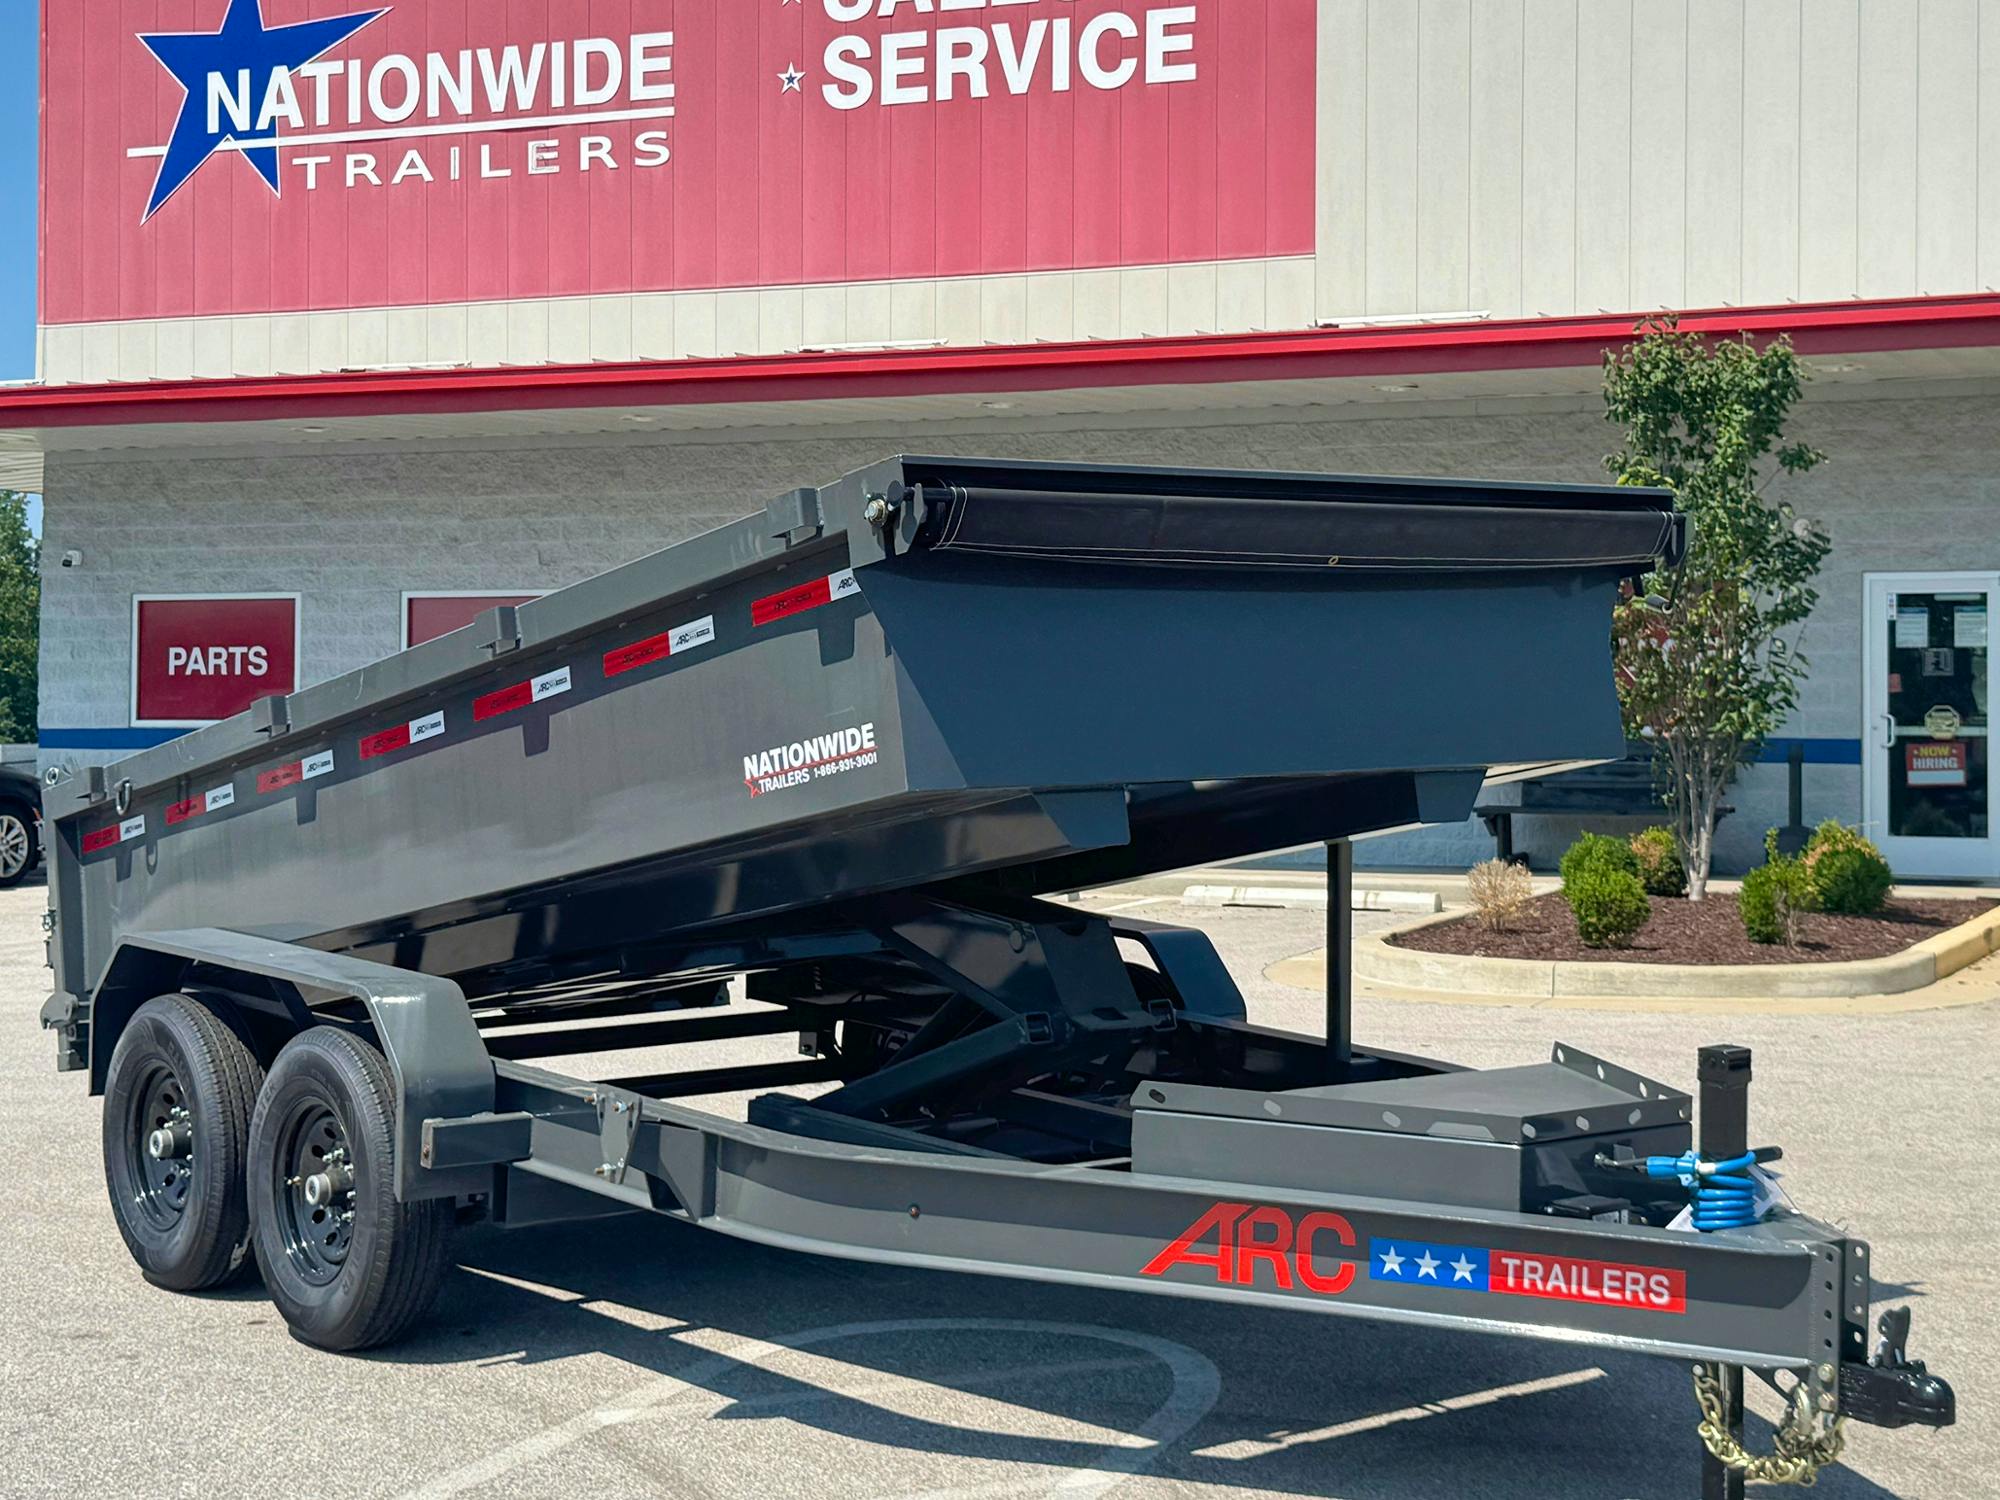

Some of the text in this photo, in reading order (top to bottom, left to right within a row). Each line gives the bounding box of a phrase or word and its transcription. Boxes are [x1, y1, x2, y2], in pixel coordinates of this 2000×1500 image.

[206, 31, 675, 134] NATIONWIDE
[821, 6, 1197, 110] SERVICE
[291, 131, 671, 190] TRAILERS
[168, 646, 268, 676] PARTS
[743, 722, 876, 780] NATIONWIDE
[758, 752, 878, 793] TRAILERS 1-866-931-3001
[1912, 757, 1958, 769] HIRING
[1919, 746, 1950, 757] NOW
[1138, 1201, 1670, 1306] ARC TRAILERS
